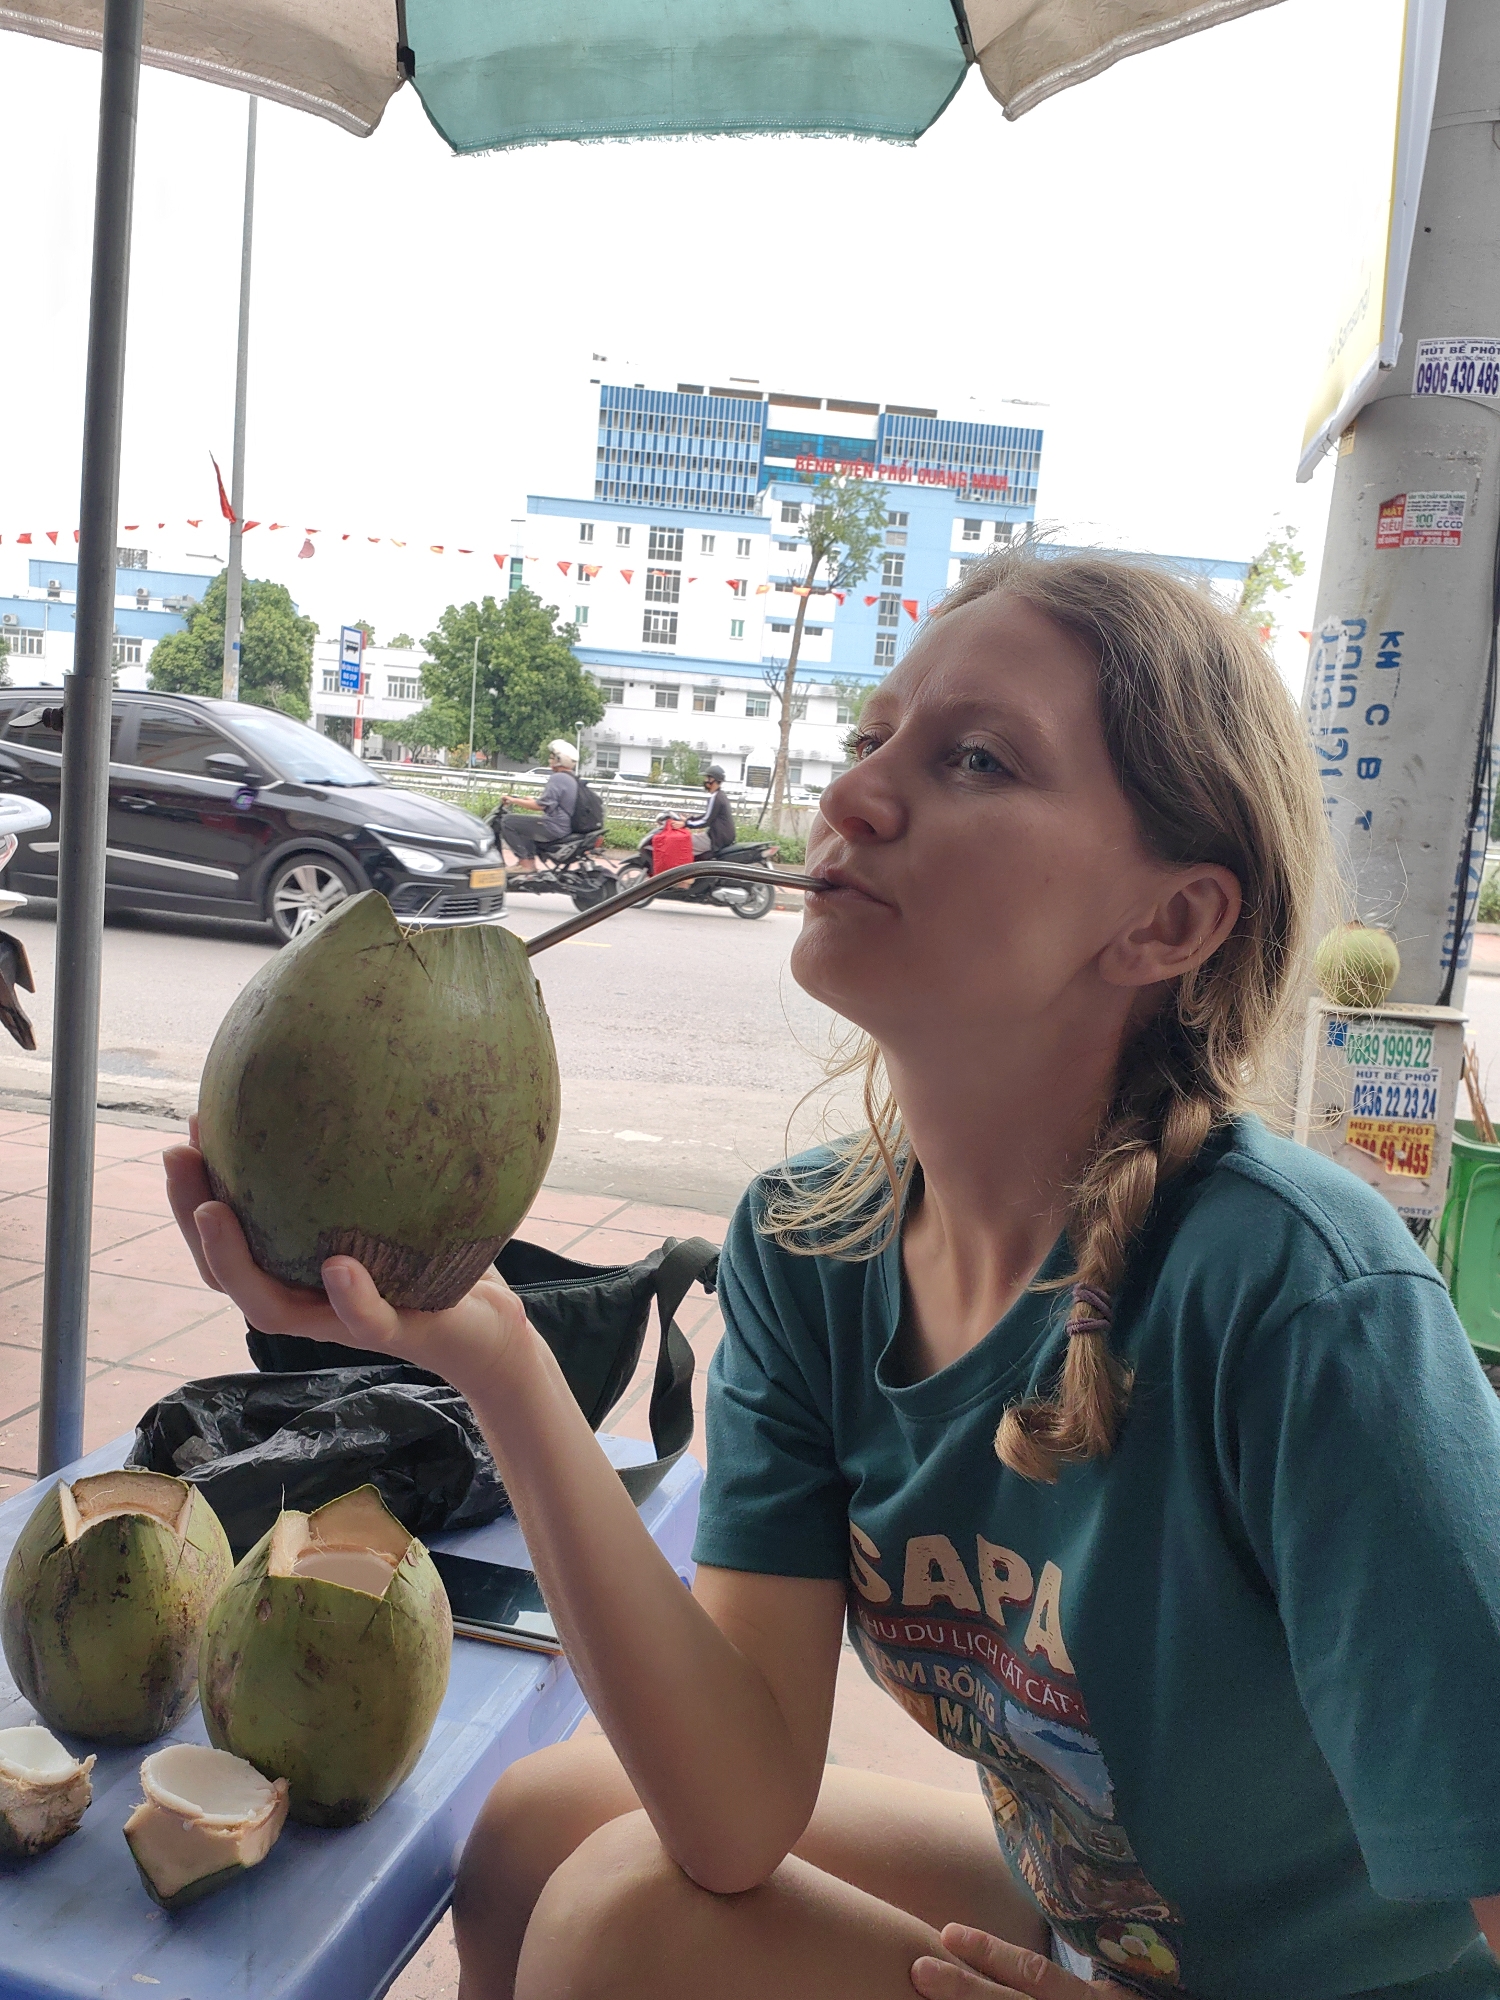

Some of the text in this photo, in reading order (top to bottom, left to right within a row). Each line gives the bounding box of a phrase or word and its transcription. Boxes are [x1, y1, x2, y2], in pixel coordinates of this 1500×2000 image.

[1450, 343, 1466, 354] BỂ
[1416, 361, 1500, 395] 0906.430.486
[1346, 1033, 1432, 1069] 0889.1999.22
[850, 1519, 1076, 1675] SAPA
[904, 1623, 945, 1644] DU
[952, 1629, 998, 1665] LỊCH
[1000, 1653, 1024, 1690] CÁT
[1025, 1679, 1073, 1714] CÁT
[933, 1664, 996, 1723] RỒNG
